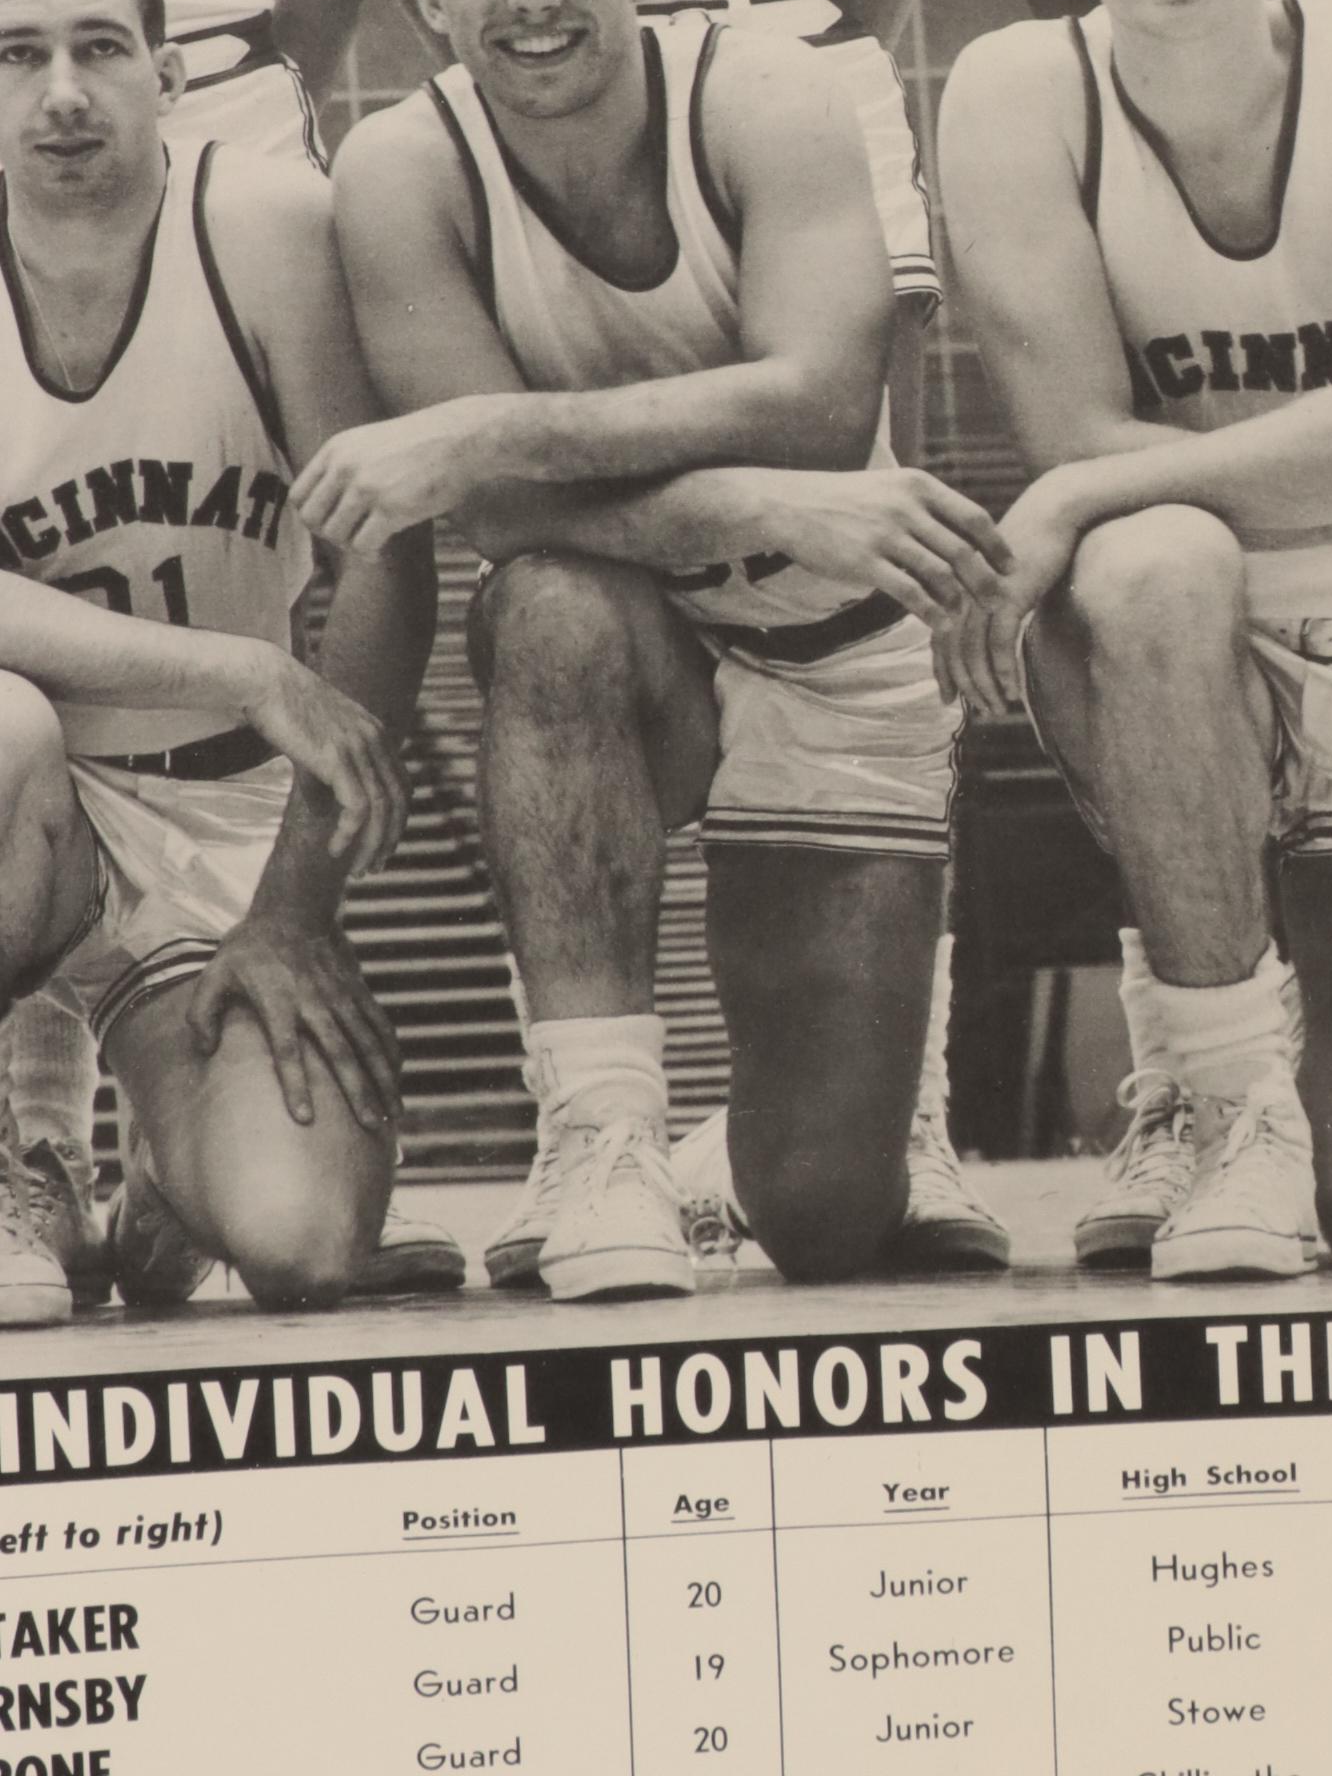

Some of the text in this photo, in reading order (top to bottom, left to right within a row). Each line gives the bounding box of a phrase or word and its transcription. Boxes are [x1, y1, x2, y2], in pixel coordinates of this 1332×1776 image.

[0, 1364, 546, 1474] INDIVIDUAL
[609, 1339, 988, 1437] HONORS
[1050, 1331, 1143, 1415] IN
[63, 1521, 101, 1550] to
[116, 1509, 223, 1550] right)
[402, 1507, 516, 1531] Position
[673, 1494, 730, 1520] Age
[882, 1483, 950, 1503] Year
[1121, 1467, 1187, 1494] High
[1206, 1462, 1297, 1486] School
[410, 1591, 515, 1625] Guard
[687, 1581, 722, 1609] 20
[870, 1569, 968, 1598] Junior
[1151, 1551, 1274, 1588] Hughes
[413, 1664, 518, 1698] Guard
[695, 1653, 725, 1681] 19
[829, 1641, 1014, 1679] Sophomore
[1168, 1623, 1260, 1653] Public
[416, 1736, 521, 1771] Guard
[694, 1726, 728, 1753] 20
[876, 1713, 974, 1742] Junior
[1168, 1697, 1266, 1726] Stowe
